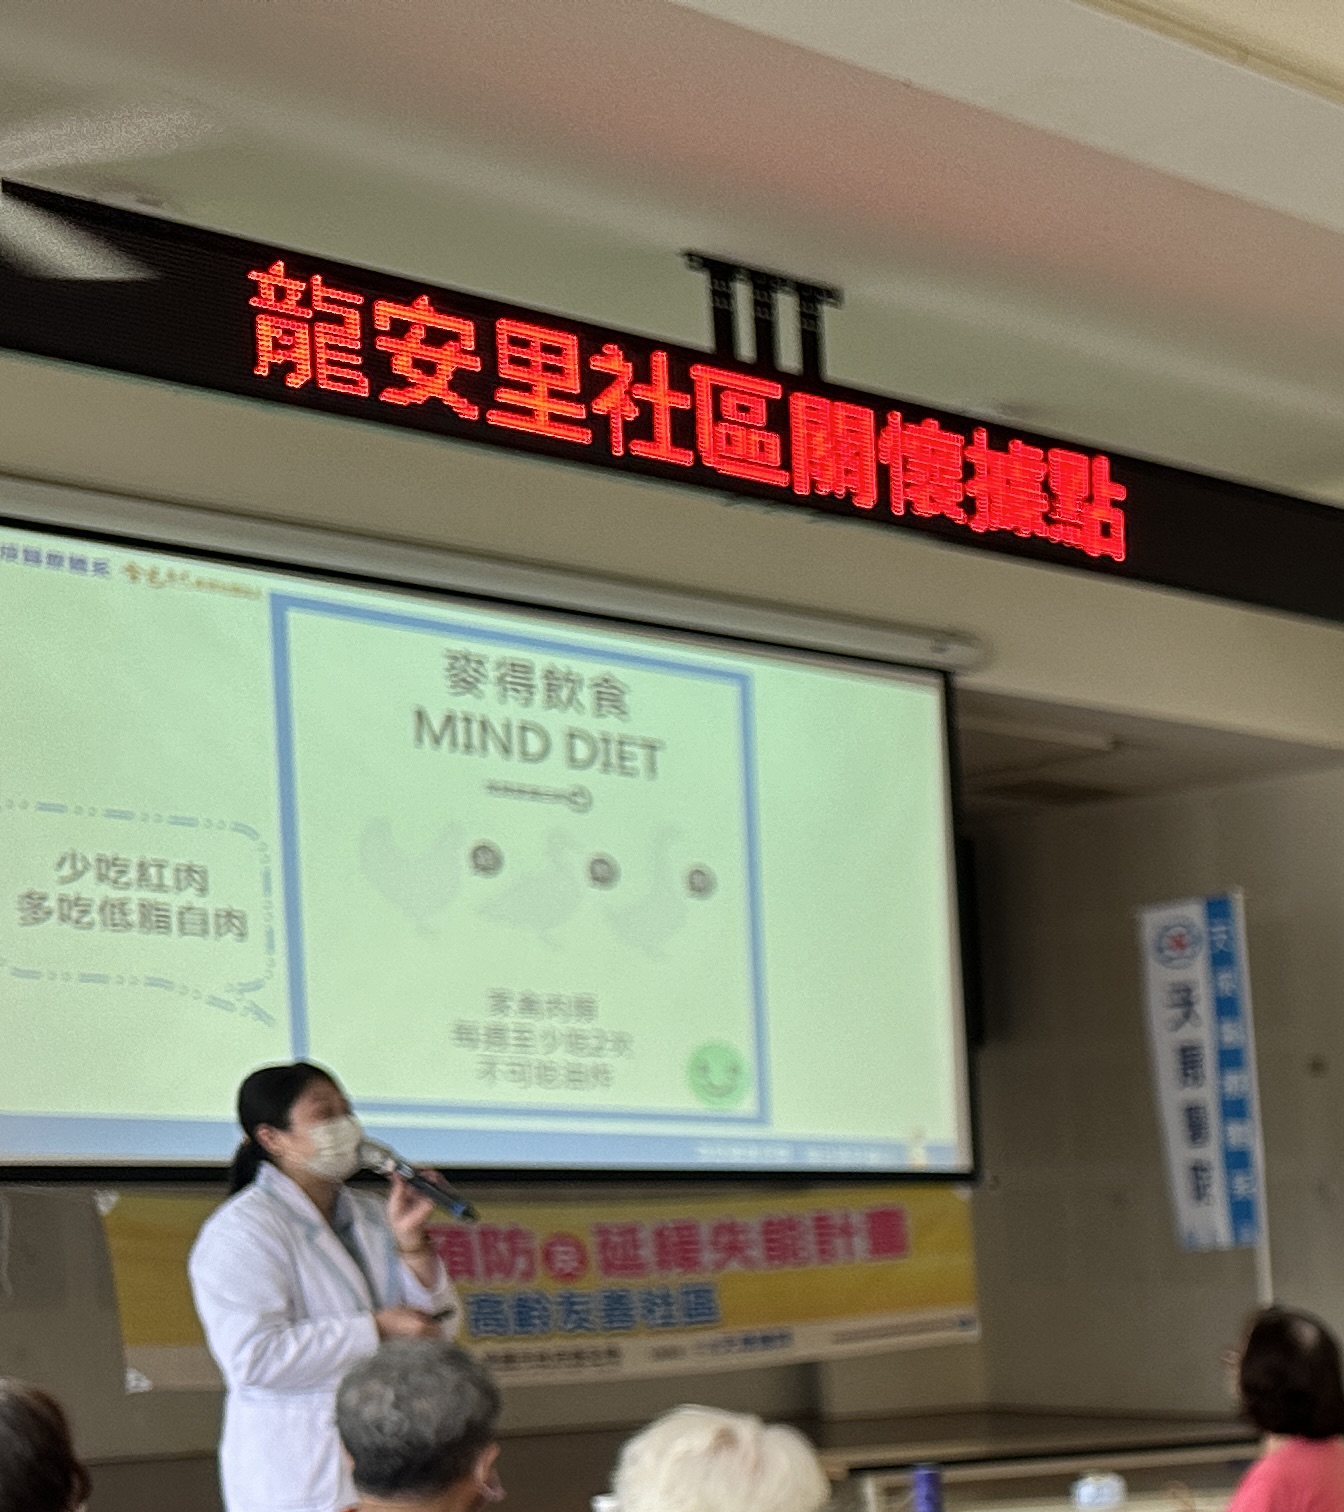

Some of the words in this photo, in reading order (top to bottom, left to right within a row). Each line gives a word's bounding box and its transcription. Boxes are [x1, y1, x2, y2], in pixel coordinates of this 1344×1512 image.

[247, 259, 1128, 563] 龍安里社區關懷據點
[445, 648, 632, 722] 麥得飲食
[413, 704, 552, 764] MIND
[564, 726, 667, 781] DIET
[54, 850, 210, 898] 少吃紅肉
[16, 889, 250, 943] 多吃低脂白肉
